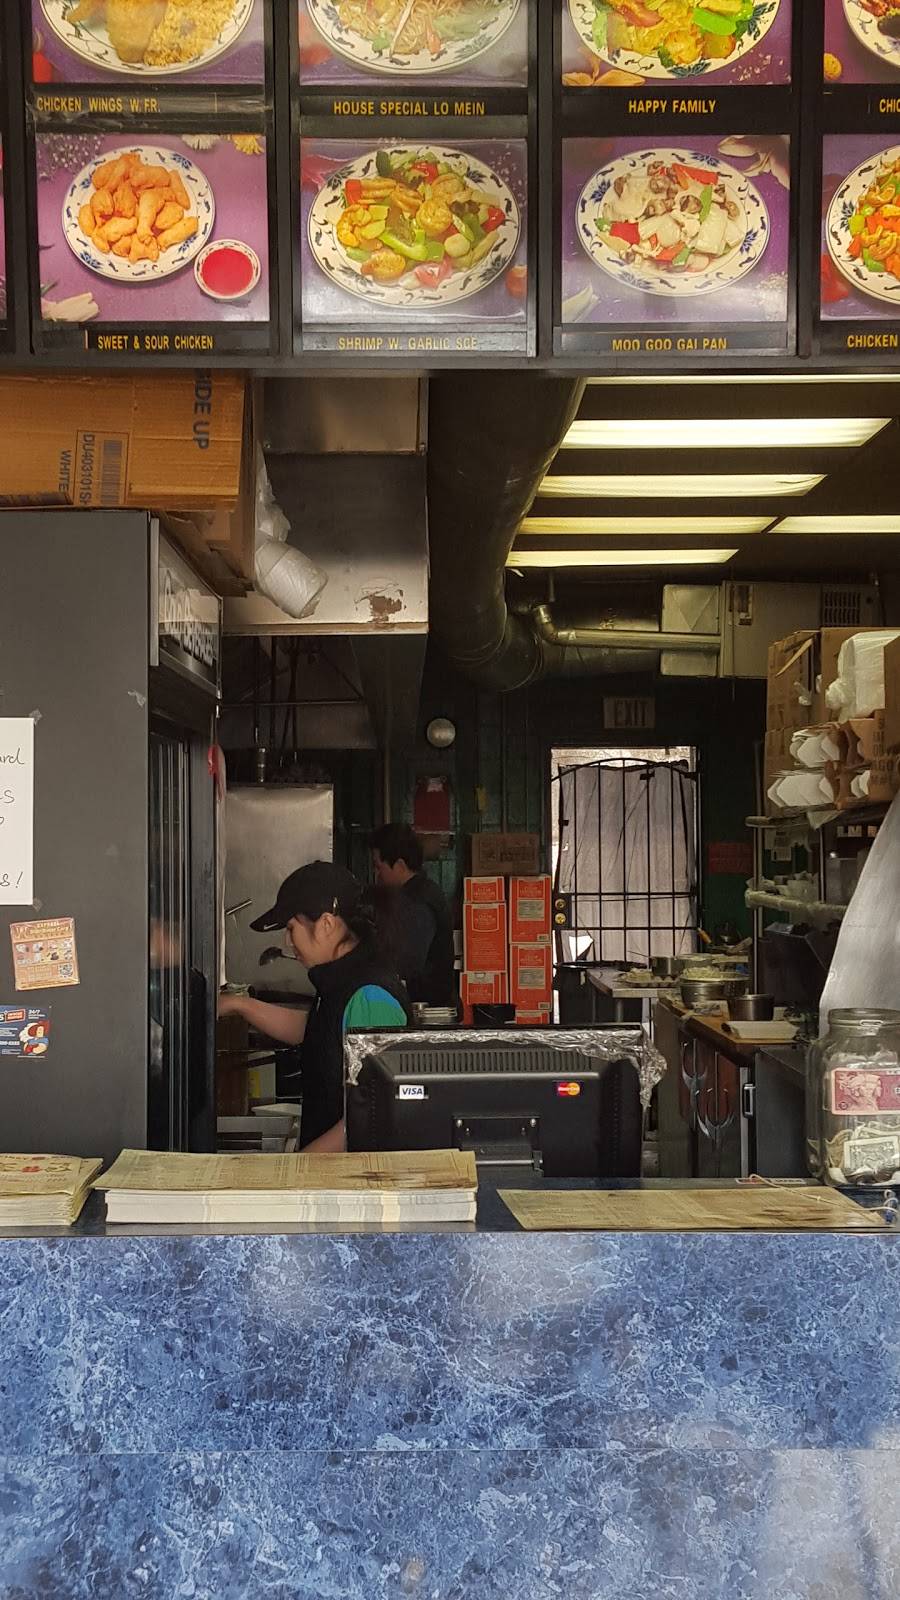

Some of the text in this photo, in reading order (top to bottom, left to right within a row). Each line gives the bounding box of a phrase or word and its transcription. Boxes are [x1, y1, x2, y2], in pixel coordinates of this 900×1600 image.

[36, 97, 82, 112] CHICKEN
[88, 97, 123, 112] WINGS
[333, 101, 485, 115] HOUSE SPECIAL LO MEIN
[628, 99, 716, 114] HAPPY FAMILY
[97, 335, 214, 349] SWEET & SOUR CHICKEN
[338, 337, 383, 351] SHRIMP
[407, 337, 450, 350] GARLIC
[456, 337, 478, 350] SCE
[612, 338, 728, 351] MOO GOO GAI PAN
[847, 334, 898, 348] CHICKEN
[193, 421, 210, 449] UP
[59, 449, 72, 492] WHITE
[401, 1087, 424, 1096] VISA
